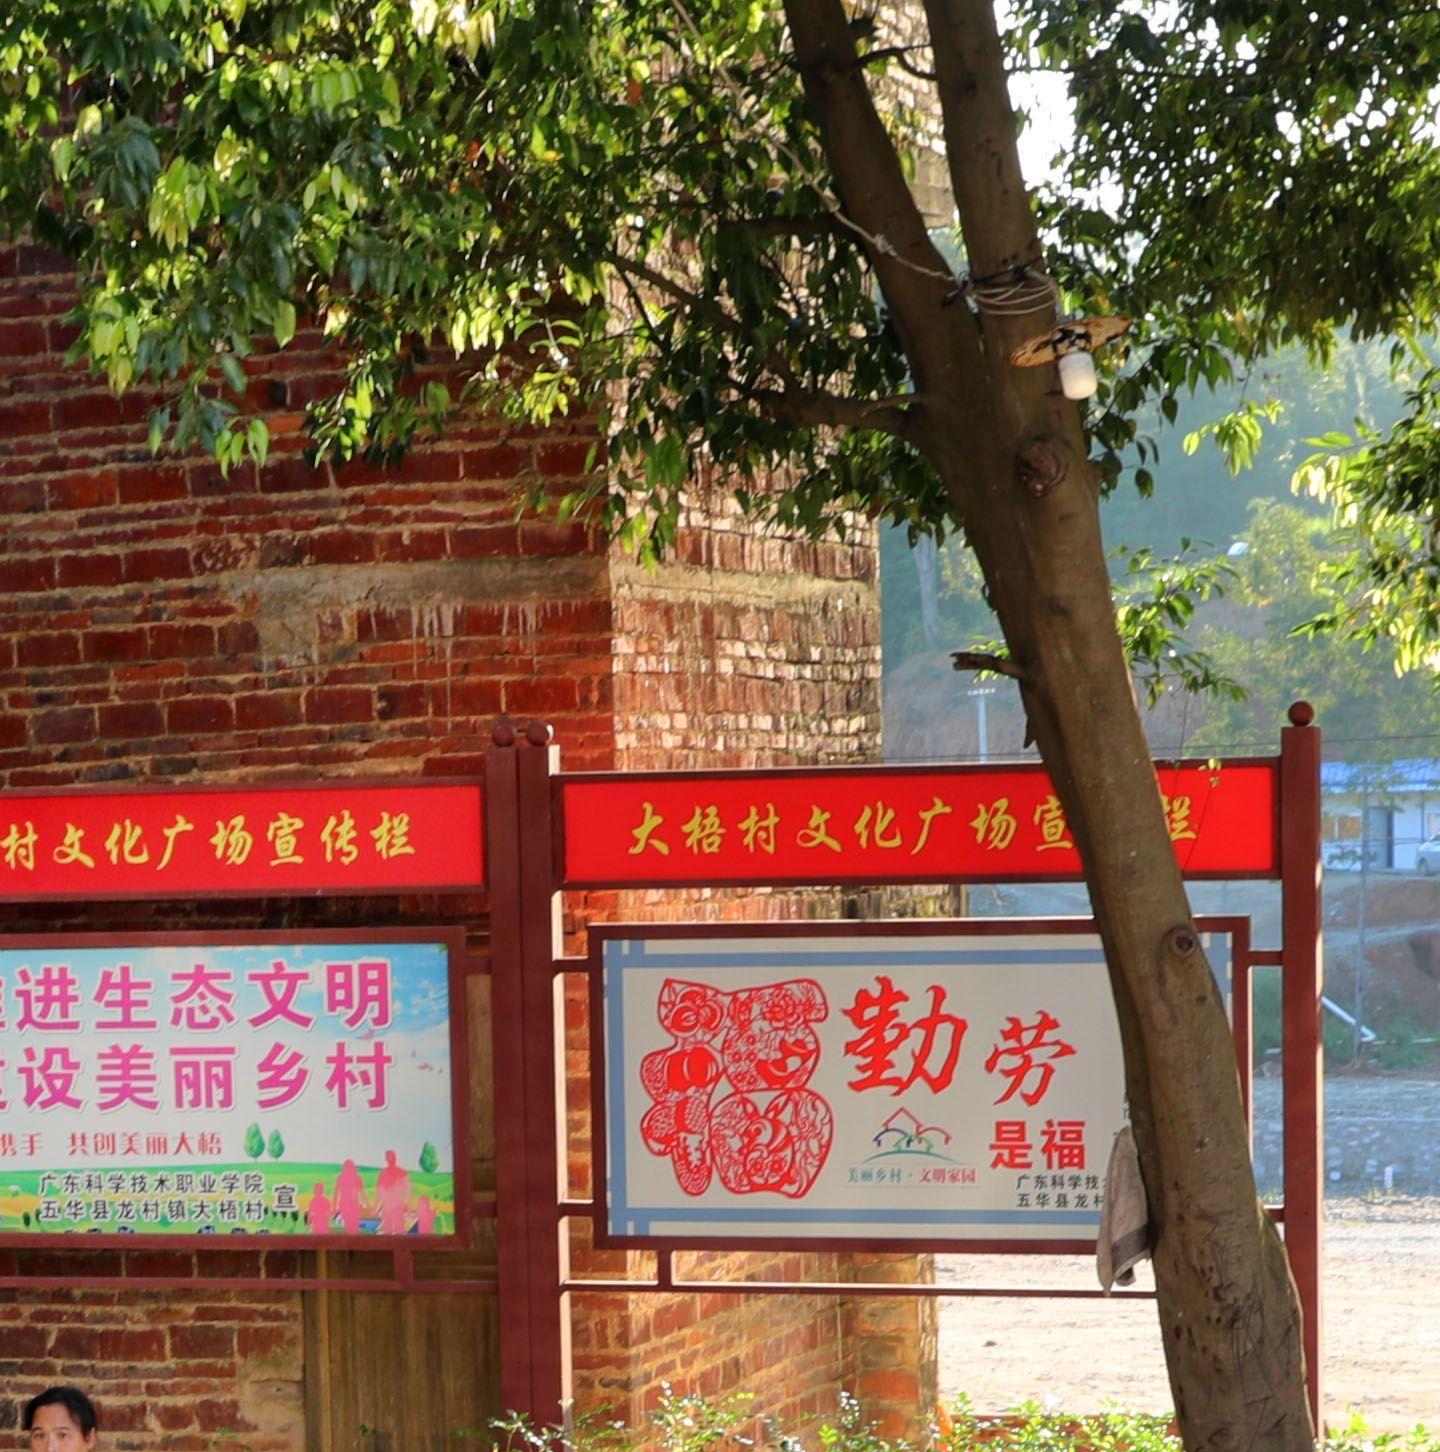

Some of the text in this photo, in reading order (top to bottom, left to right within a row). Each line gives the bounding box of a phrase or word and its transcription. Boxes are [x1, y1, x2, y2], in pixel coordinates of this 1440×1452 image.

[628, 795, 1197, 853] 大梧村文化广场宣栏
[841, 975, 1077, 1107] 勤劳
[67, 1132, 223, 1157] 共创美丽大梧
[988, 1119, 1087, 1171] 是福
[39, 1172, 266, 1196] 广东科学技术职业学院
[1016, 1173, 1108, 1190] 广东科学技
[40, 1199, 263, 1221] 五华县龙村镇大梧村
[273, 1184, 297, 1212] 宣
